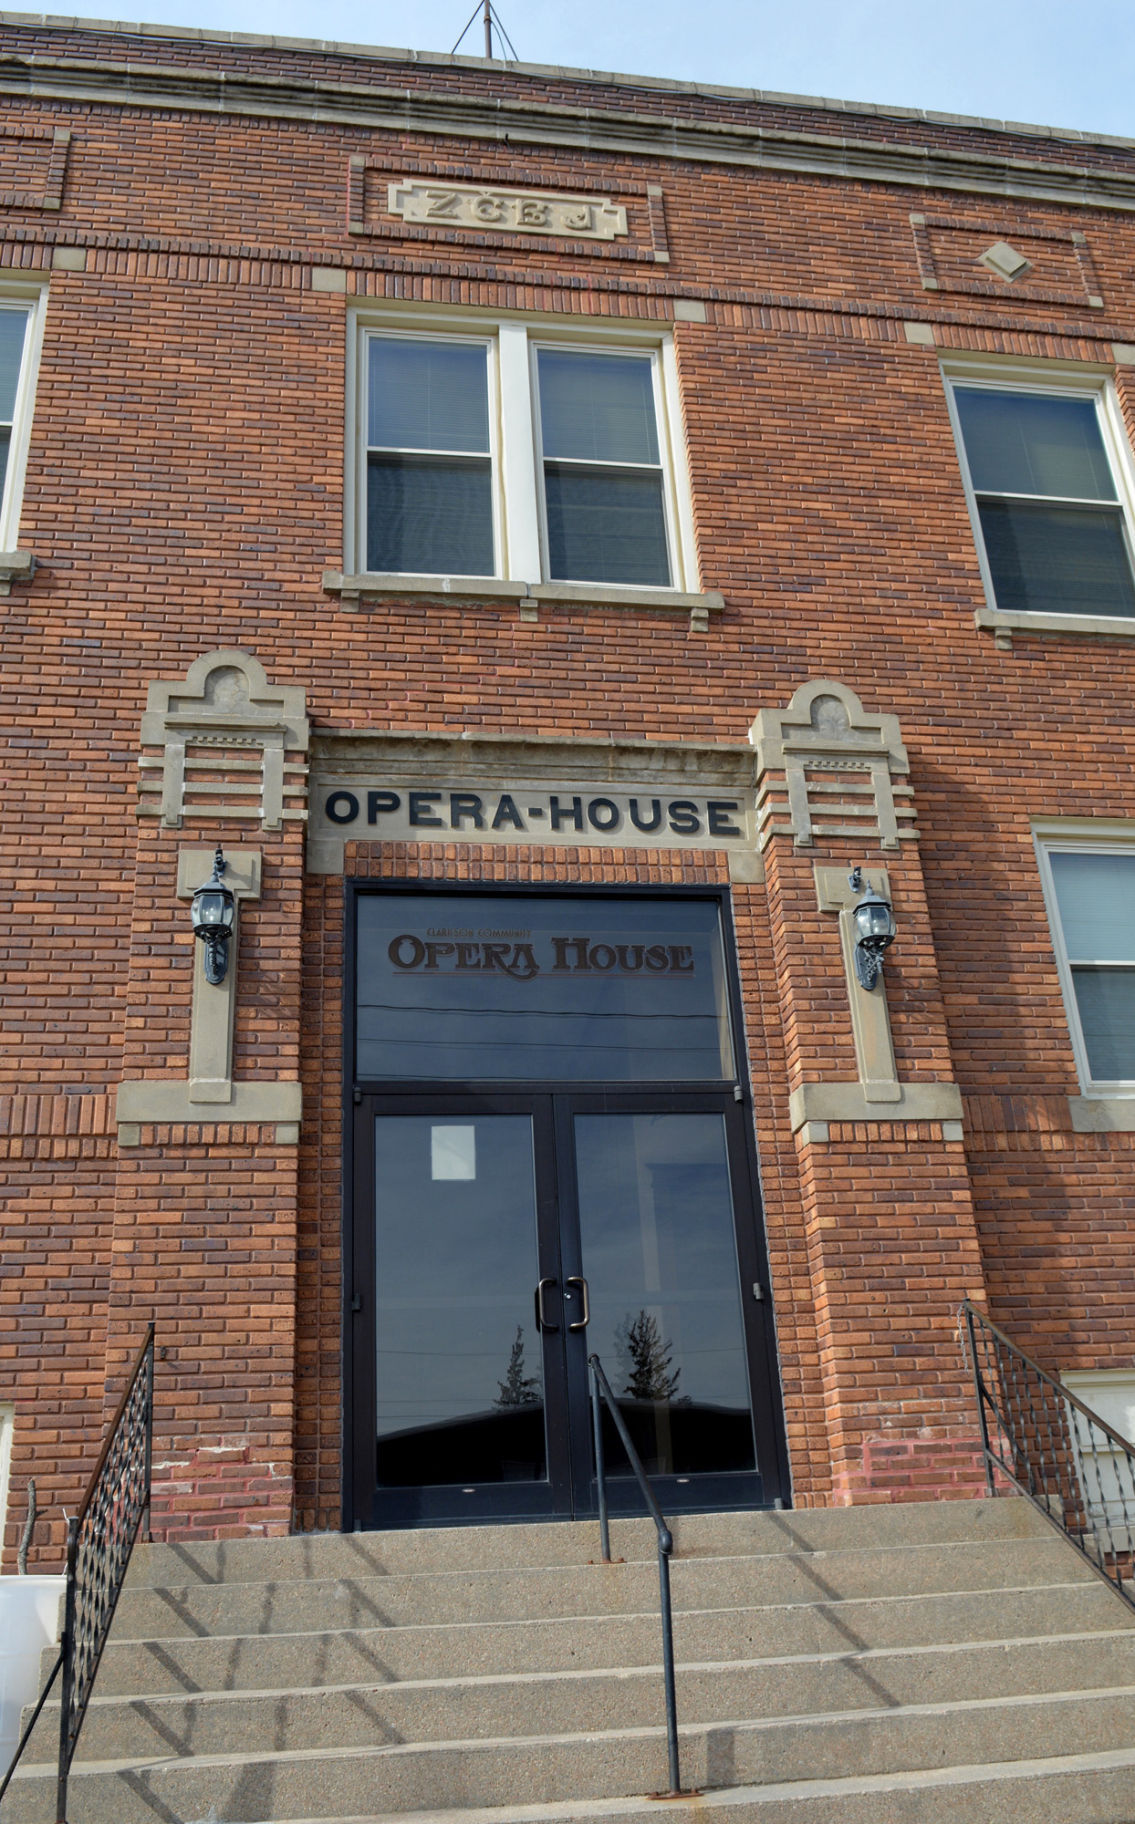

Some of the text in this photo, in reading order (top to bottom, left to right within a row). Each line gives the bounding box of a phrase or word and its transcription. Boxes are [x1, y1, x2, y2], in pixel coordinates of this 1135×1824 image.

[325, 790, 740, 836] OPERA-HOUSE
[478, 928, 532, 938] COMMUNITY
[388, 934, 695, 981] OPERA HOUSE
